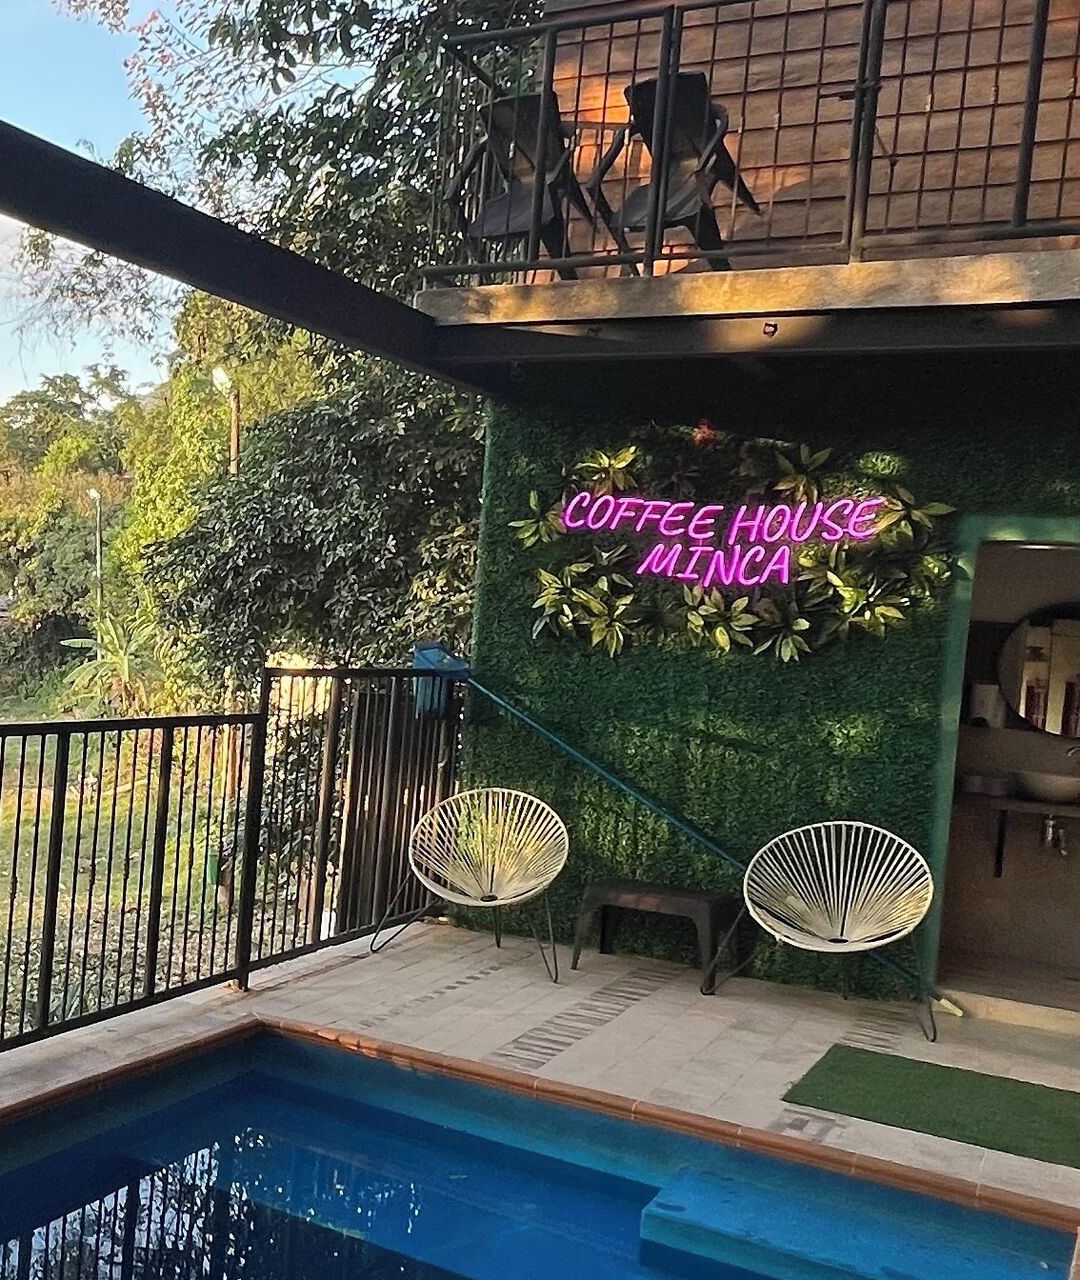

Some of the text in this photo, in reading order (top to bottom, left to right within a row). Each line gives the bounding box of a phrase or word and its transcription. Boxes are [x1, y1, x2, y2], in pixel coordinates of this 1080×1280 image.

[563, 491, 886, 546] COFFEE HOUSE
[636, 542, 790, 587] MINCA
